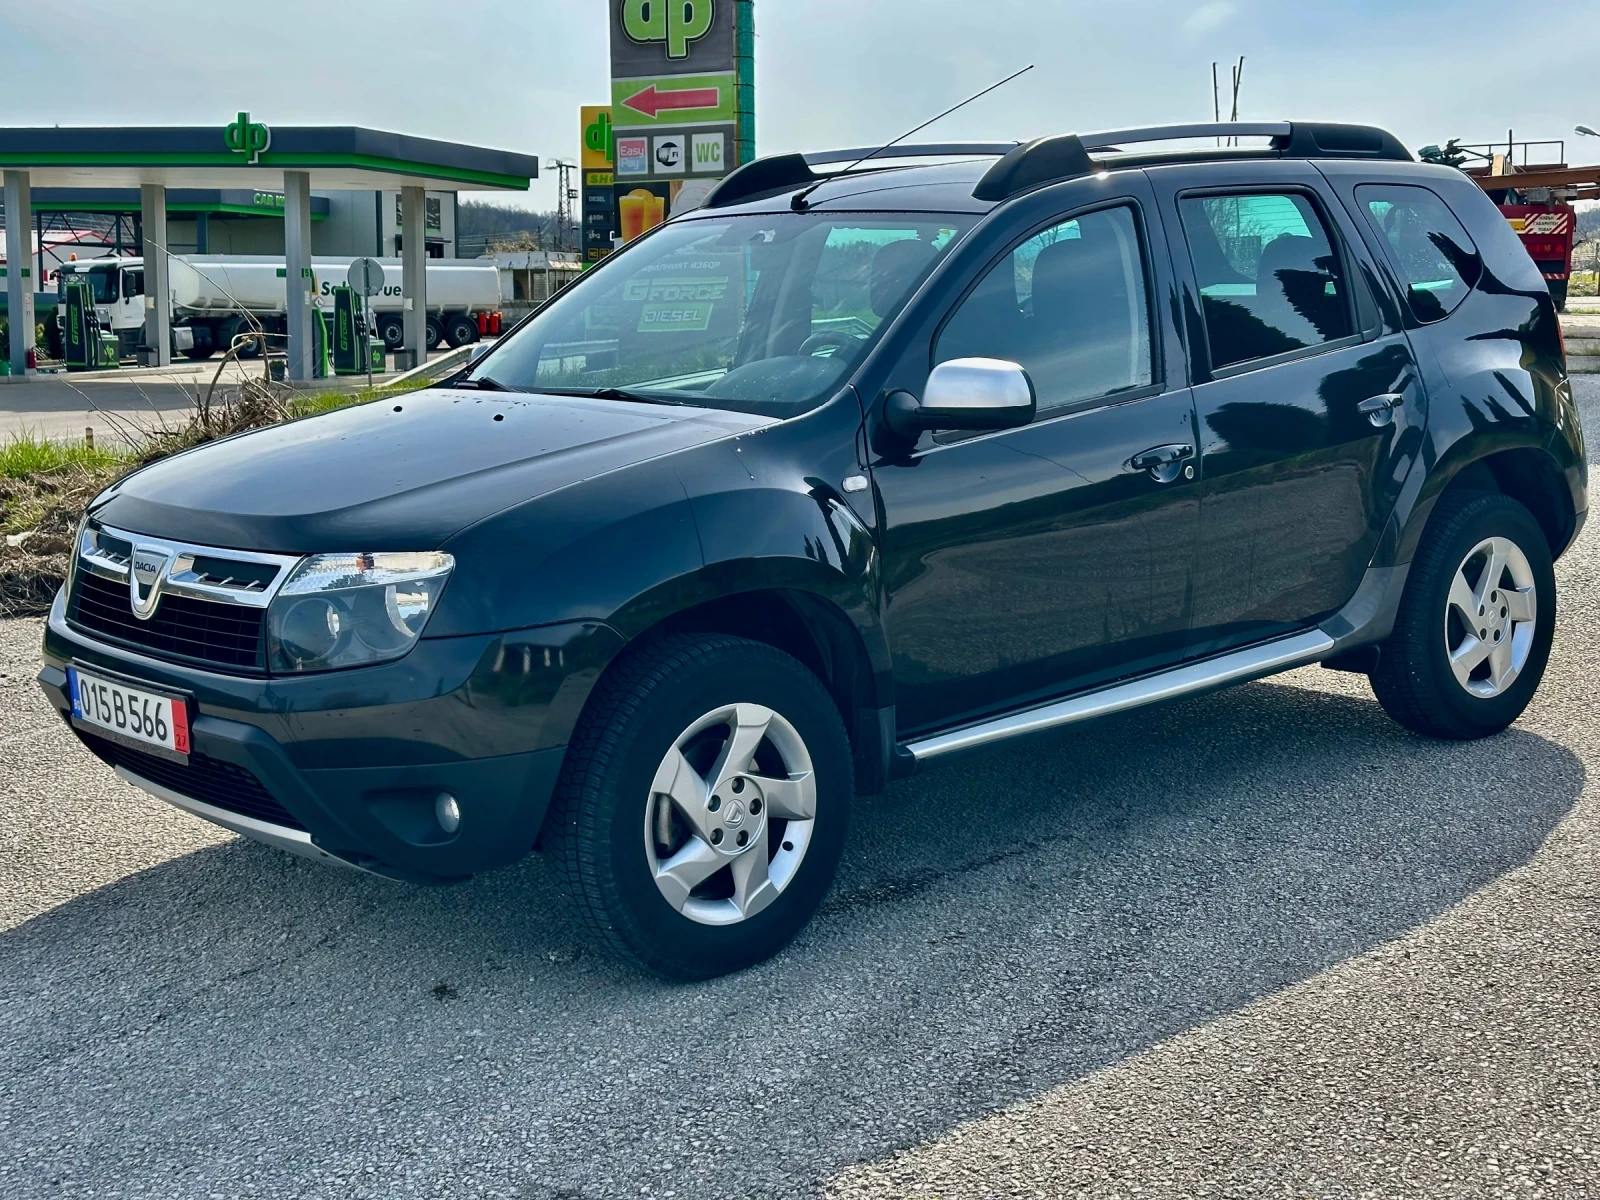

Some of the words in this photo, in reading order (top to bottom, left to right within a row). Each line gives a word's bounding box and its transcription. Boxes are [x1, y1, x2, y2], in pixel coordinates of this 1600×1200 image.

[224, 111, 271, 164] dp
[586, 112, 612, 162] d
[620, 145, 645, 158] Easy
[696, 142, 720, 163] WC
[621, 159, 640, 170] Pay
[590, 174, 612, 184] SH
[253, 193, 274, 206] CAR
[690, 261, 721, 269] ИЗБОР
[644, 310, 702, 323] DIESEL
[134, 560, 156, 574] DACIA
